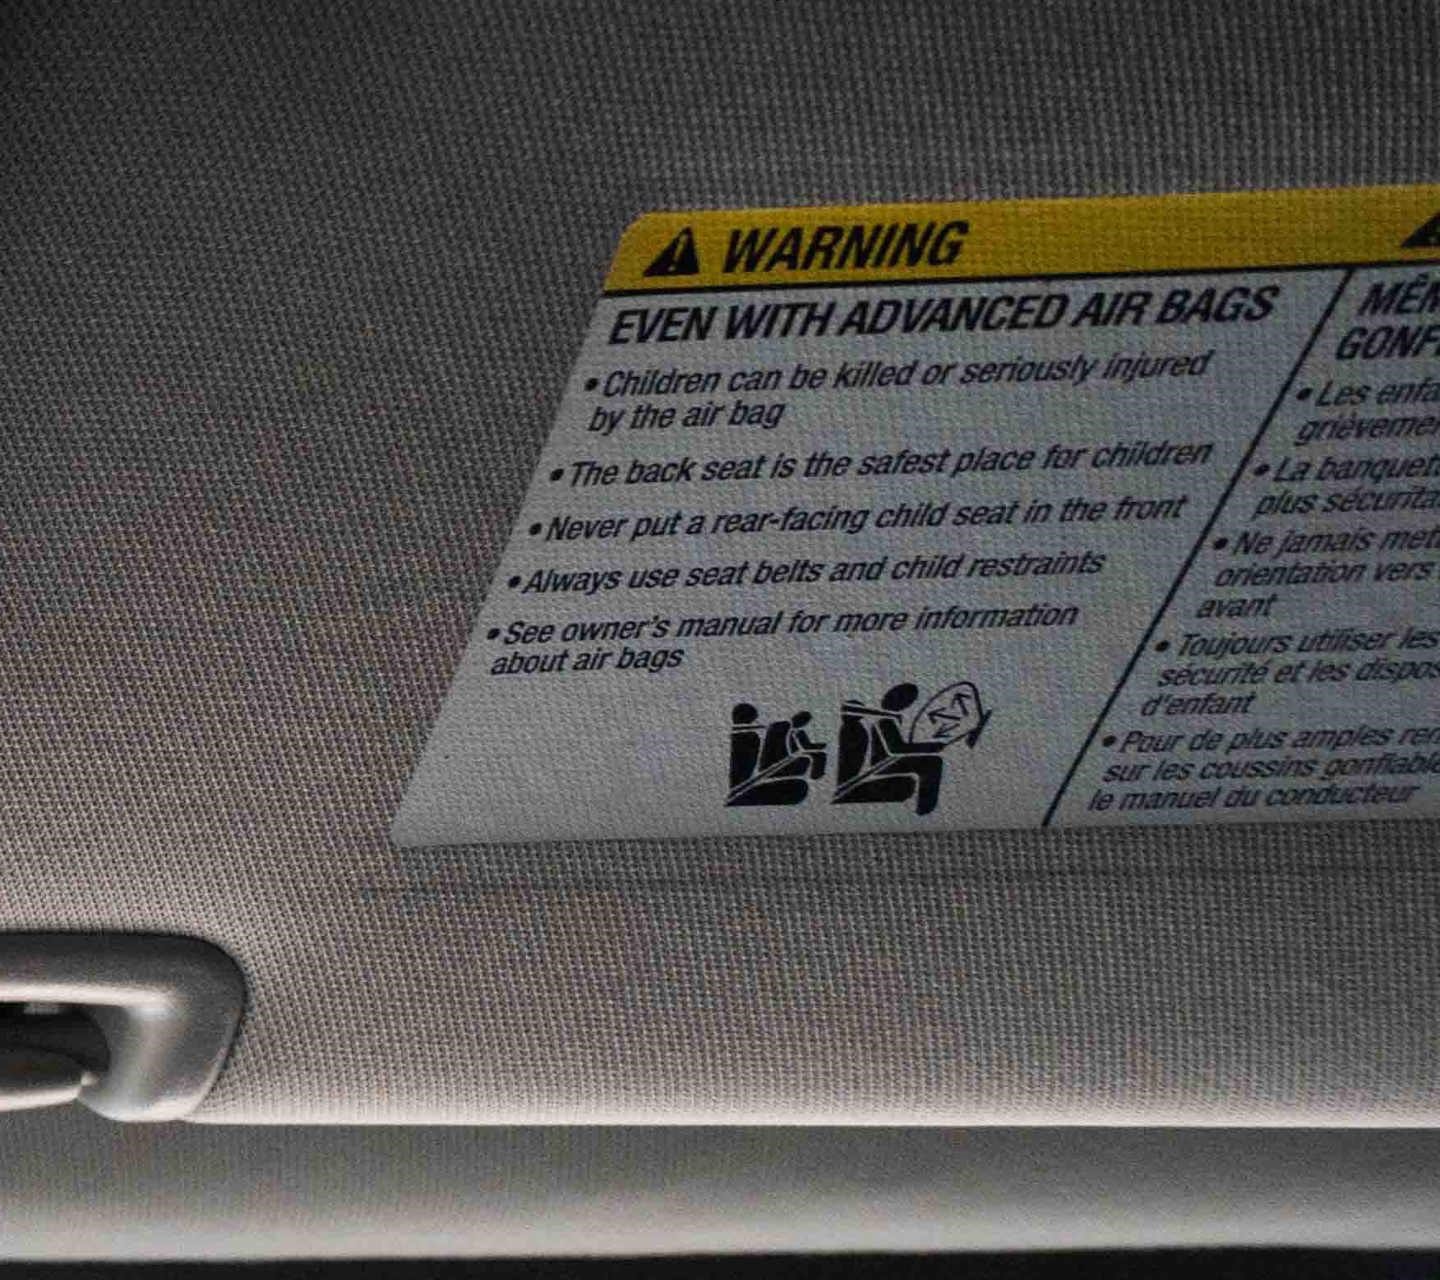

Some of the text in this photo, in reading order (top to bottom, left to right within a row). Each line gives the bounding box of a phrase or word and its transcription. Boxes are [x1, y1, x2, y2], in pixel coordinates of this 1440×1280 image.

[722, 220, 971, 274] WARNING
[608, 285, 1281, 345] EVEN WITH ADVANCED AIR BAGS
[1334, 323, 1440, 362] GONF
[603, 349, 1216, 399] Children can be killed or seriously injured
[1314, 383, 1367, 409] Les
[588, 400, 786, 437] by the air bag
[569, 440, 1214, 487] The back seat is the safest place for children
[1273, 458, 1308, 483] La
[545, 494, 1189, 543] Never put a rear-facing child seat in the front
[1253, 490, 1323, 521] plus
[1231, 530, 1277, 556] Ne
[1273, 527, 1376, 560] jamais
[521, 550, 1107, 597] Always use seat belts and child restraints
[1214, 560, 1435, 588] orientation vers
[1196, 593, 1278, 619] avant
[502, 603, 1081, 646] See owner's manual for more information
[1177, 626, 1438, 660] Toujours utiliser les
[490, 644, 685, 676] about air bags
[1272, 661, 1306, 685] et
[1307, 660, 1349, 683] les
[1140, 691, 1257, 718] d'enfant
[1118, 729, 1186, 754] Pour
[1187, 730, 1224, 752] de
[1225, 726, 1289, 755] plus
[1291, 724, 1392, 752] amples
[1102, 763, 1154, 783] sur
[1152, 756, 1195, 781] les
[1198, 755, 1319, 780] coussins
[1088, 782, 1419, 812] le manuel du conducteur
